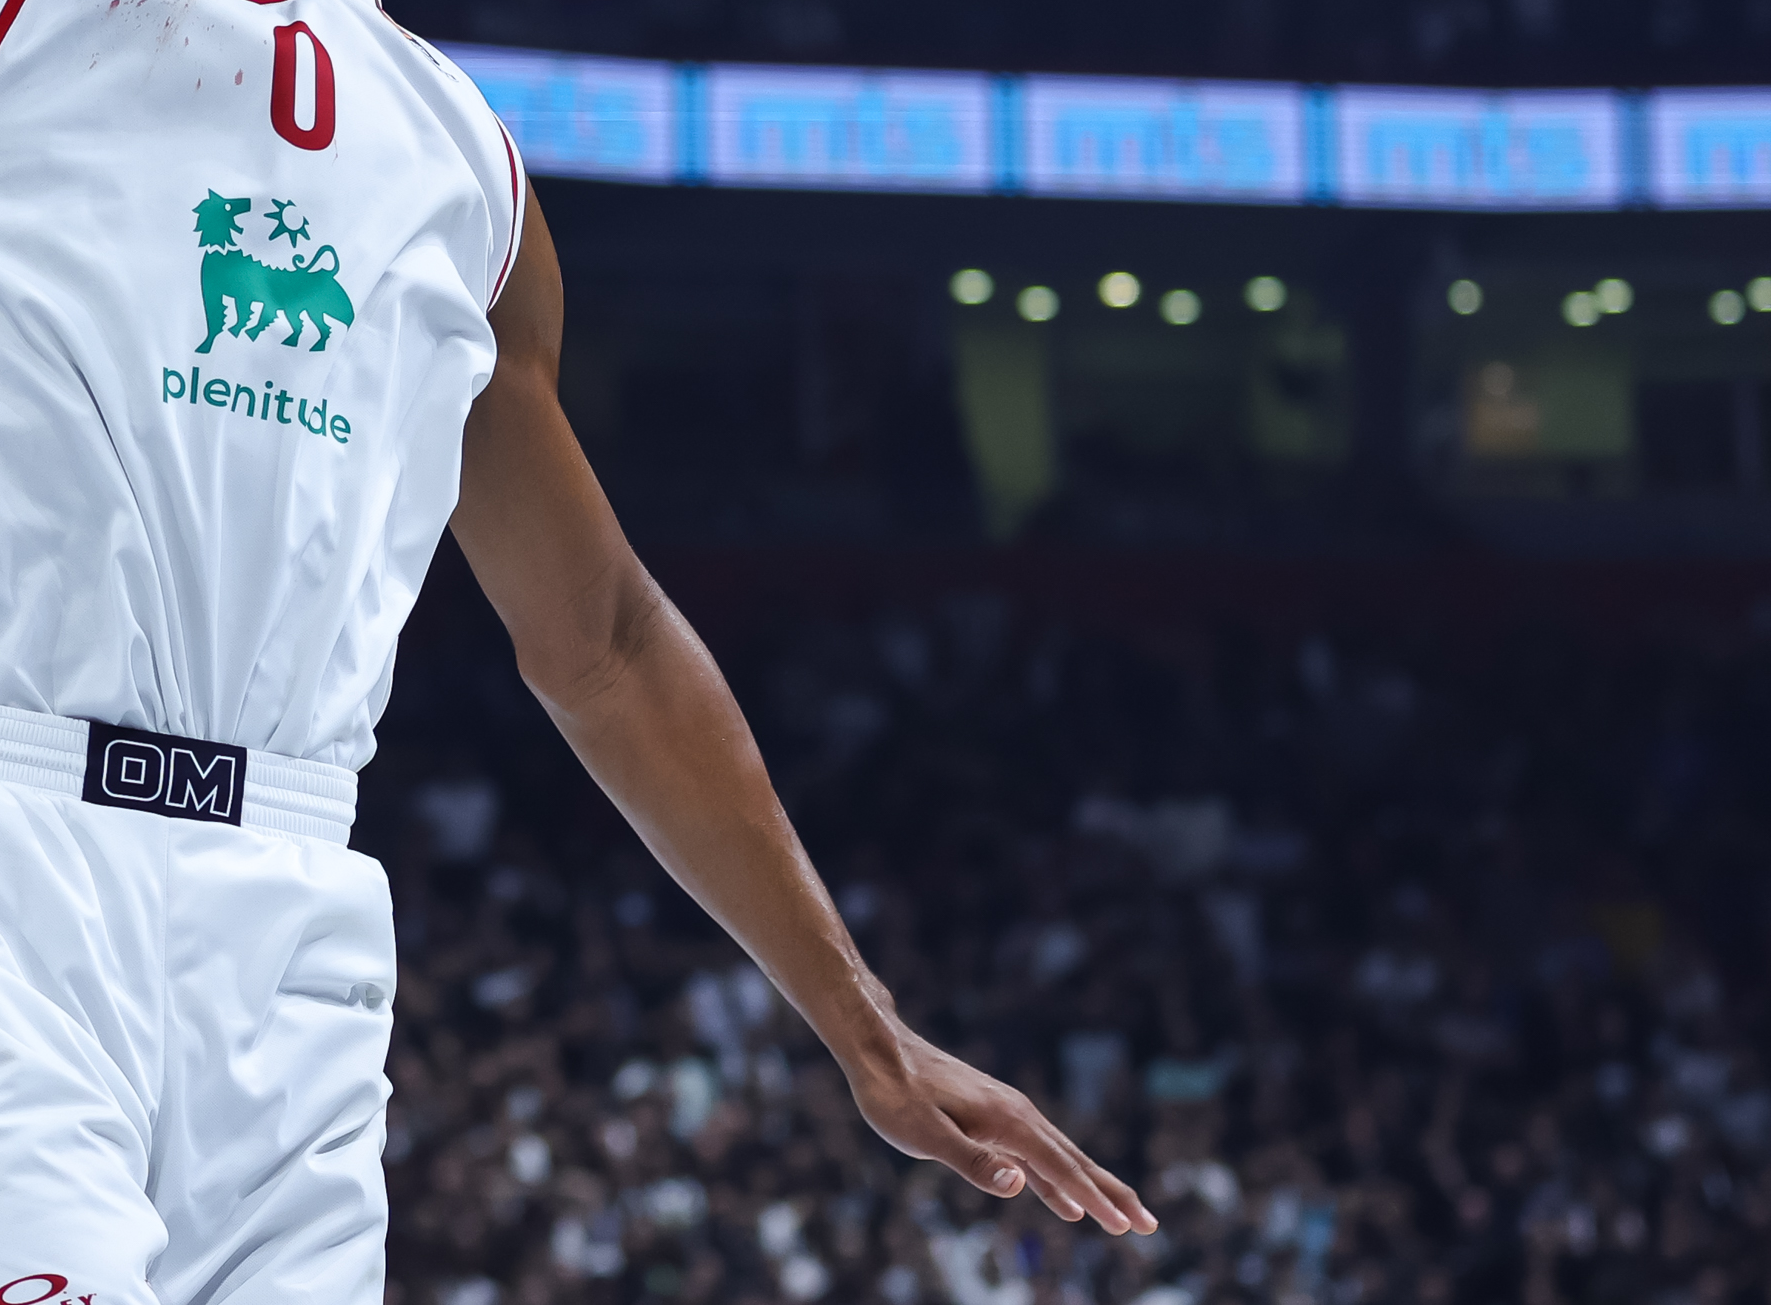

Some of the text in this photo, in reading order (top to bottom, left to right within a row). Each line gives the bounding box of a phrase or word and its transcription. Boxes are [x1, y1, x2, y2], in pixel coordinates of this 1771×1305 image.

[270, 20, 336, 151] 0
[162, 366, 351, 444] plenitude
[102, 739, 236, 817] OM
